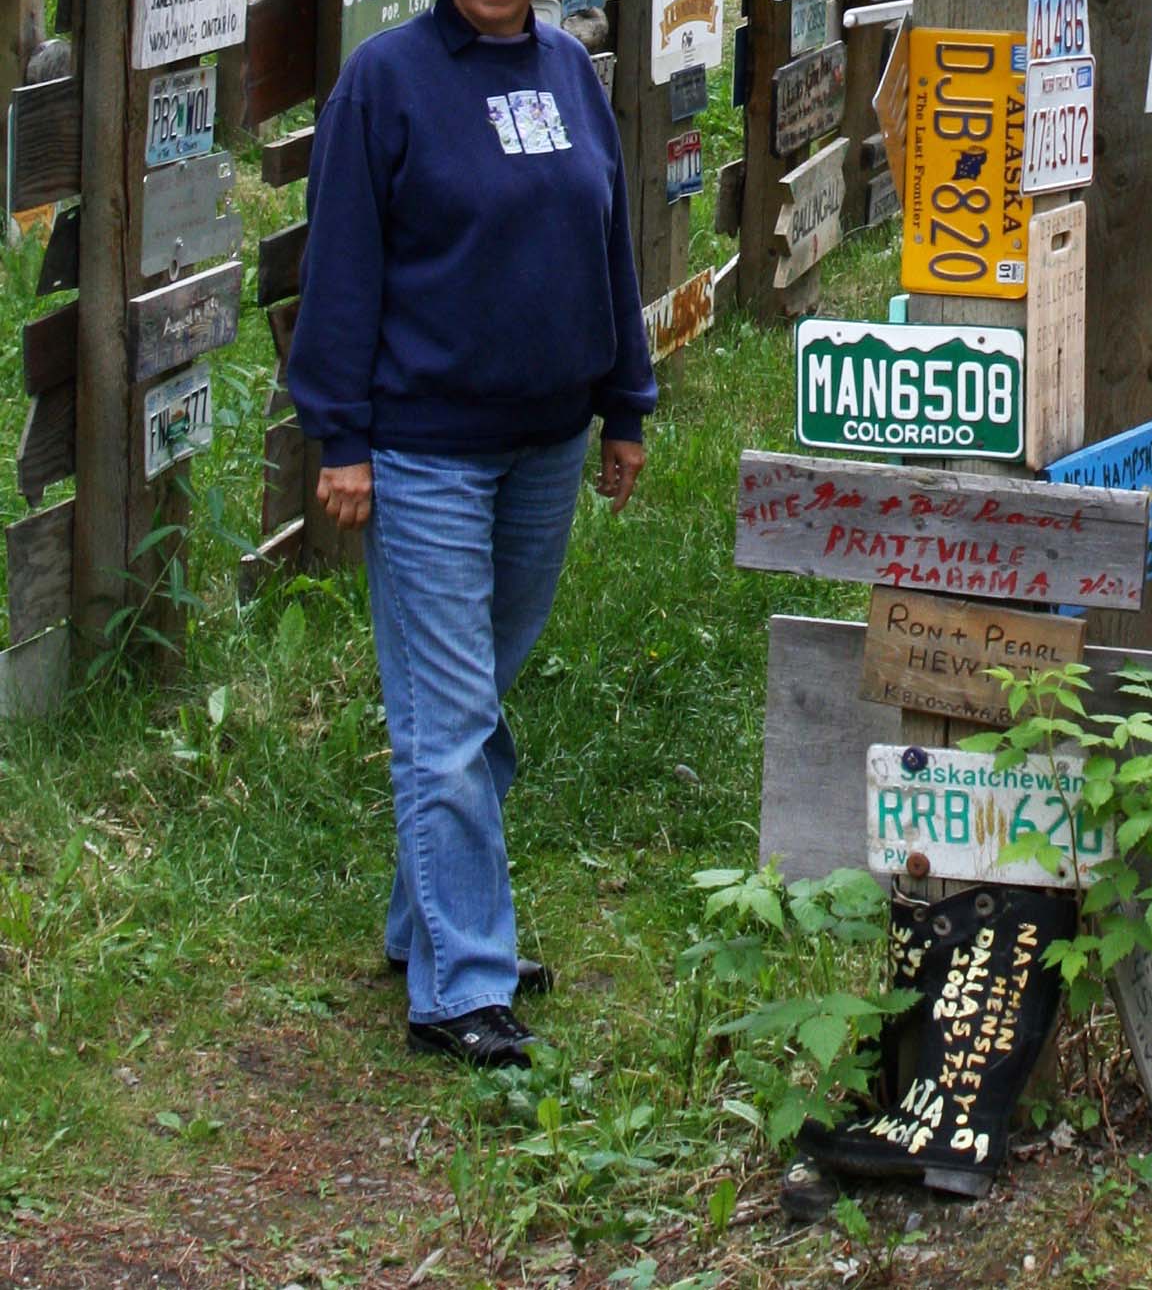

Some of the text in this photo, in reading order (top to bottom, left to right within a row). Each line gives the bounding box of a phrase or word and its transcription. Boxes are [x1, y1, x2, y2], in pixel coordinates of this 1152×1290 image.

[200, 13, 238, 42] ONTARIO
[912, 91, 929, 230] The Last Frontier
[927, 40, 995, 283] DJB 820
[1002, 94, 1026, 236] ALASKA
[808, 354, 1013, 423] MAN6508
[843, 420, 975, 447] COLORADO
[822, 522, 1026, 569] PRATTVILLE
[875, 561, 1052, 599] ALABAMA
[886, 600, 1064, 666] RON PEARL
[898, 761, 1088, 795] Saskatchewan
[876, 787, 972, 846] RRB
[883, 847, 910, 866] PV
[993, 921, 1038, 1052] NATHAN
[938, 1049, 967, 1089] TX
[952, 974, 1009, 1113] HENSLEY
